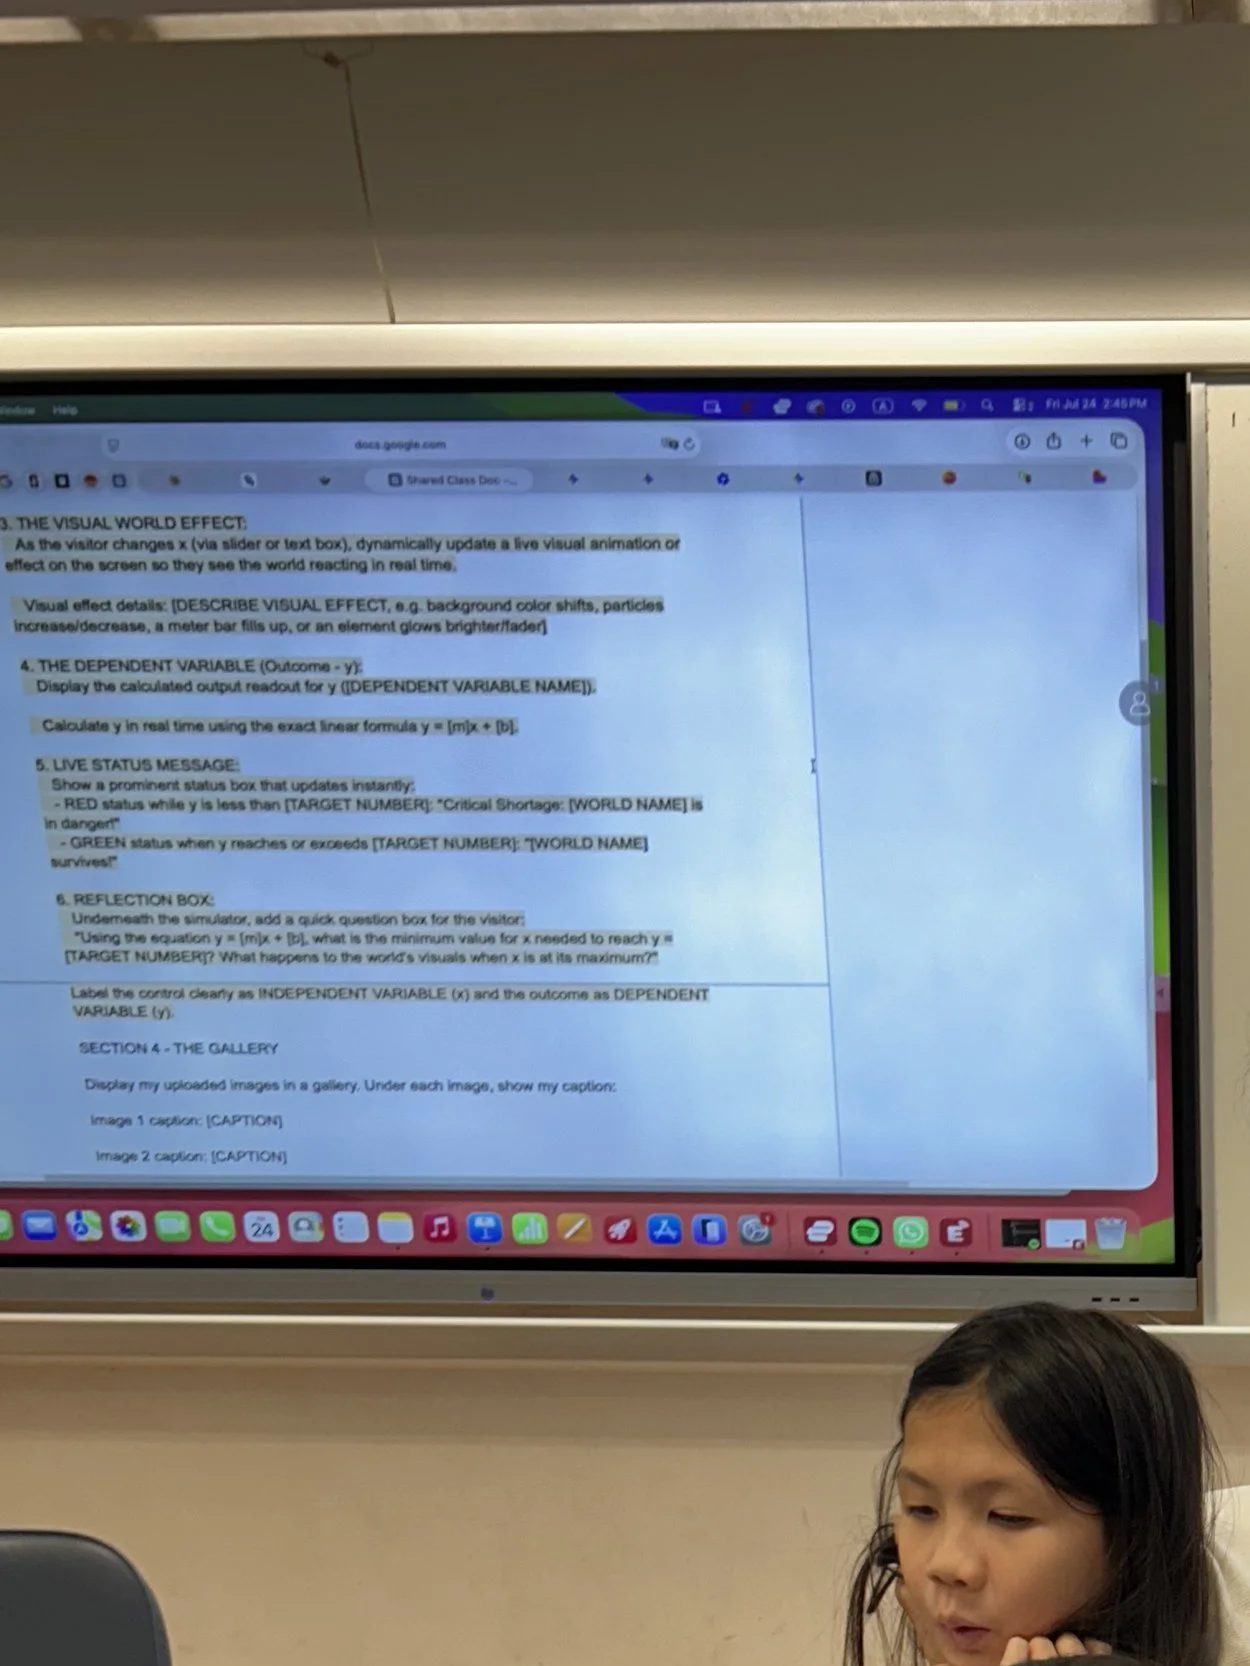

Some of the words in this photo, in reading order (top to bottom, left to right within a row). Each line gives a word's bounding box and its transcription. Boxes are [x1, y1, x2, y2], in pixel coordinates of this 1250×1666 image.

[53, 404, 79, 416] Help
[1082, 398, 1096, 410] 24
[354, 439, 446, 452] docs.google.com
[407, 474, 444, 486] Shared
[447, 474, 476, 486] Class
[479, 474, 500, 486] Doc
[18, 517, 48, 530] THE
[53, 517, 112, 530] VISUAL
[115, 516, 177, 530] WORLD
[15, 538, 34, 550] As
[39, 539, 61, 550] the
[65, 539, 108, 550] visitor
[113, 538, 174, 553] changes
[178, 540, 187, 550] x
[223, 538, 260, 550] slider
[265, 540, 280, 550] or
[284, 538, 311, 549] text
[356, 536, 442, 553] dynamically
[446, 538, 495, 552] update
[501, 540, 509, 550] a
[514, 537, 538, 550] live
[543, 537, 585, 550] visual
[591, 536, 661, 550] animation
[665, 538, 680, 550] or
[6, 560, 45, 572] effect
[48, 561, 67, 572] on
[71, 560, 93, 572] the
[99, 561, 147, 572] screen
[152, 561, 168, 570] so
[173, 560, 204, 574] they
[208, 560, 234, 571] see
[239, 559, 261, 570] the
[266, 558, 305, 571] world
[310, 559, 368, 574] reacting
[371, 558, 385, 571] in
[390, 558, 416, 572] real
[24, 600, 68, 612] Visual
[74, 599, 112, 612] effect
[262, 598, 321, 612] VISUAL
[426, 599, 512, 616] background
[516, 599, 551, 612] color
[603, 599, 664, 615] particles
[155, 622, 164, 632] a
[168, 620, 209, 632] meter
[213, 620, 237, 632] bar
[242, 620, 264, 632] fills
[296, 622, 310, 632] or
[317, 622, 334, 632] an
[338, 620, 396, 632] element
[400, 620, 441, 636] glows
[38, 659, 69, 672] THE
[74, 659, 172, 672] DEPENDENT
[177, 660, 255, 672] VARIABLE
[36, 680, 89, 695] Display
[94, 681, 116, 692] the
[120, 680, 193, 692] calculated
[197, 680, 241, 694] output
[246, 680, 300, 692] readout
[304, 680, 323, 692] for
[328, 684, 336, 696] y
[452, 680, 530, 693] VARIABLE
[52, 759, 88, 772] LIVE
[92, 758, 152, 772] STATUS
[52, 778, 91, 791] Show
[109, 779, 180, 794] prominent
[185, 780, 226, 791] status
[230, 780, 256, 792] box
[260, 780, 287, 792] that
[291, 780, 348, 794] updates
[64, 798, 98, 810] RED
[103, 799, 144, 810] status
[148, 798, 184, 810] while
[201, 799, 212, 810] is
[217, 798, 245, 810] less
[250, 800, 280, 810] than
[692, 798, 703, 811] is
[44, 818, 57, 829] in
[74, 894, 172, 906] REFLECTION
[73, 1006, 146, 1017] VARIABLE
[80, 1042, 147, 1054] SECTION
[173, 1042, 204, 1054] THE
[208, 1042, 278, 1054] GALLERY
[91, 1116, 132, 1128] Image
[96, 1152, 137, 1164] Image
[251, 1222, 273, 1238] 24
